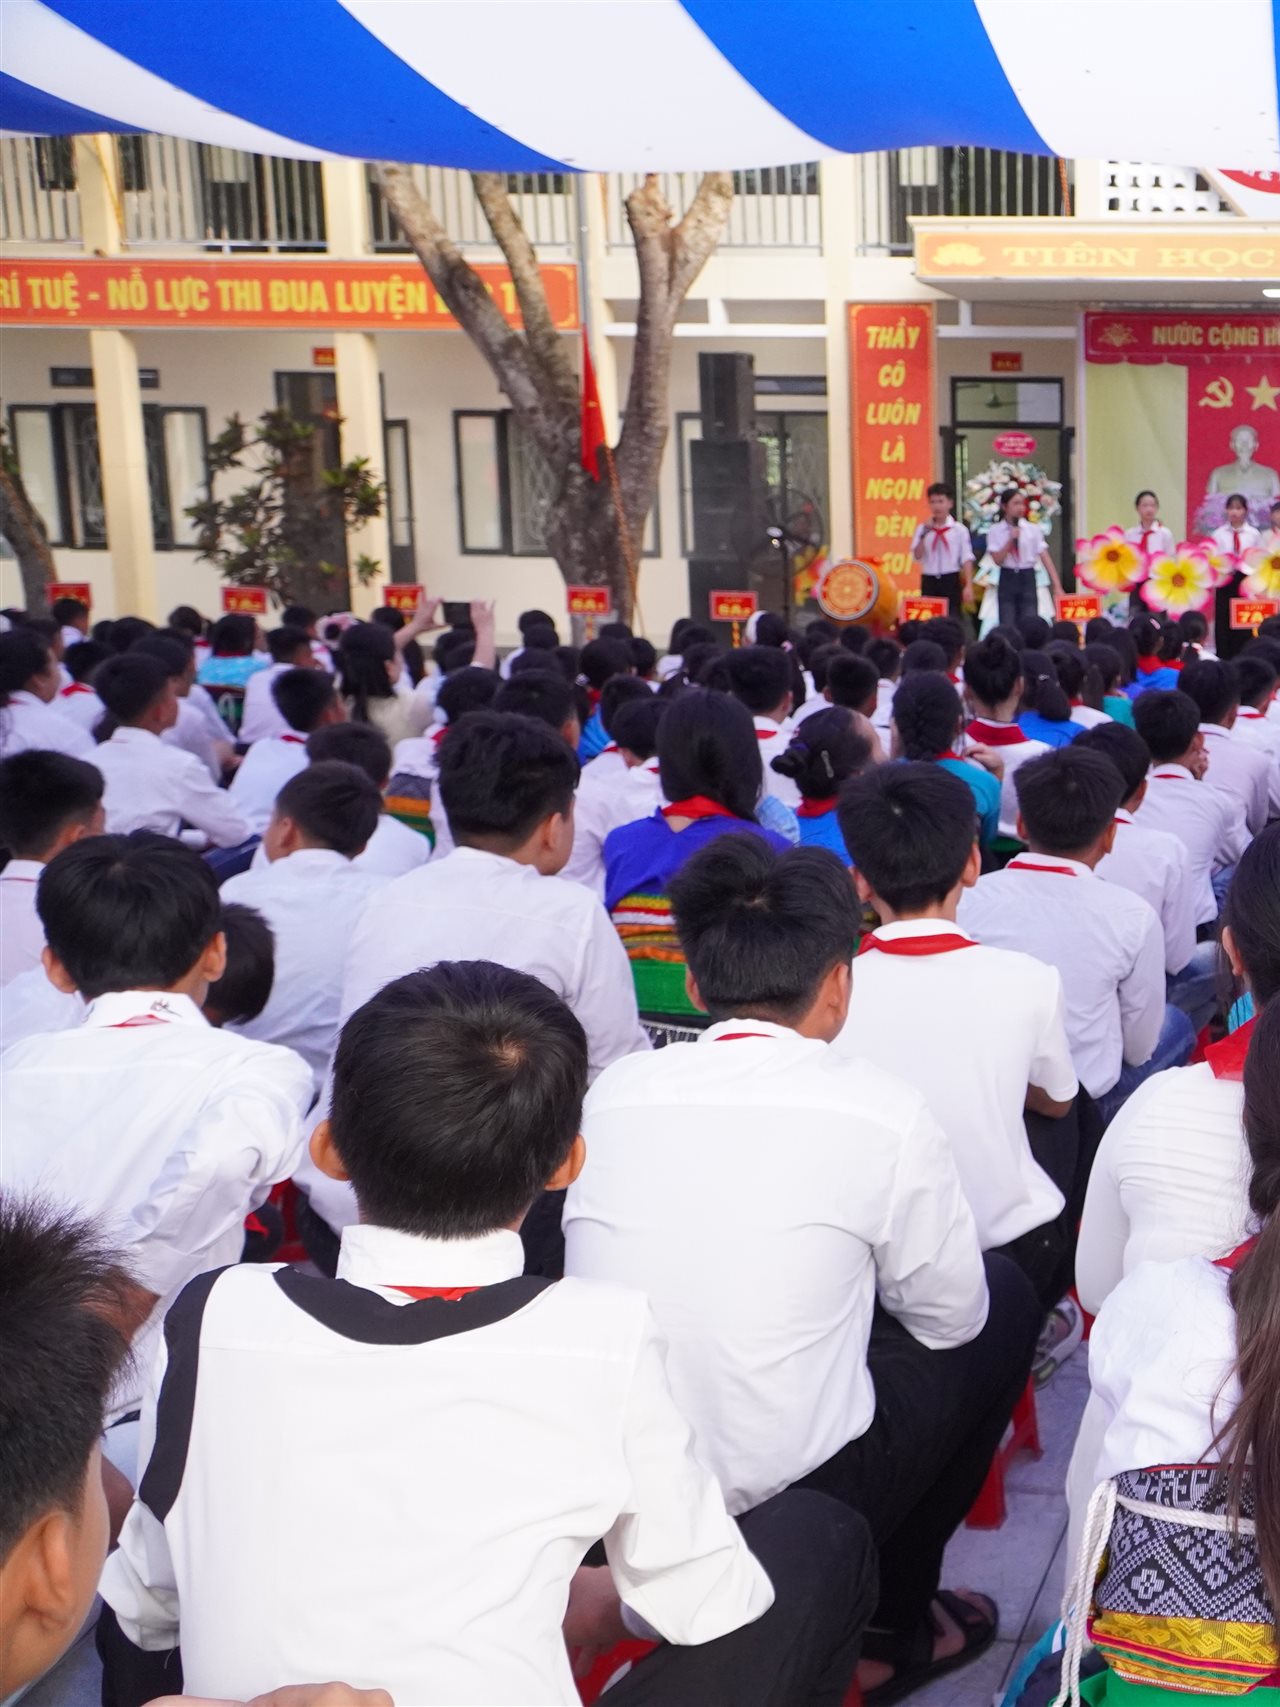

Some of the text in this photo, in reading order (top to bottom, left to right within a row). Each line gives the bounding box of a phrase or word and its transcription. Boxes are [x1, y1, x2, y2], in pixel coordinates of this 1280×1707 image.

[1002, 240, 1138, 268] TIÊN
[1155, 247, 1275, 272] HỌC
[27, 271, 81, 317] TUỆ
[107, 266, 149, 310] NỖ
[155, 274, 210, 318] LỰC
[215, 278, 262, 312] THI
[268, 280, 330, 313] ĐUA
[335, 274, 428, 320] LUYỆN
[865, 316, 921, 350] THẦY
[1152, 320, 1204, 346] NƯỚC
[1208, 322, 1260, 350] CỘNG
[878, 358, 906, 388] CÔ
[865, 396, 922, 426] LUÔN
[881, 434, 906, 463] LÀ
[865, 477, 925, 504] NGỌN
[875, 509, 917, 538] ĐÈN
[881, 551, 914, 576] SOI
[1238, 610, 1268, 623] 7A
